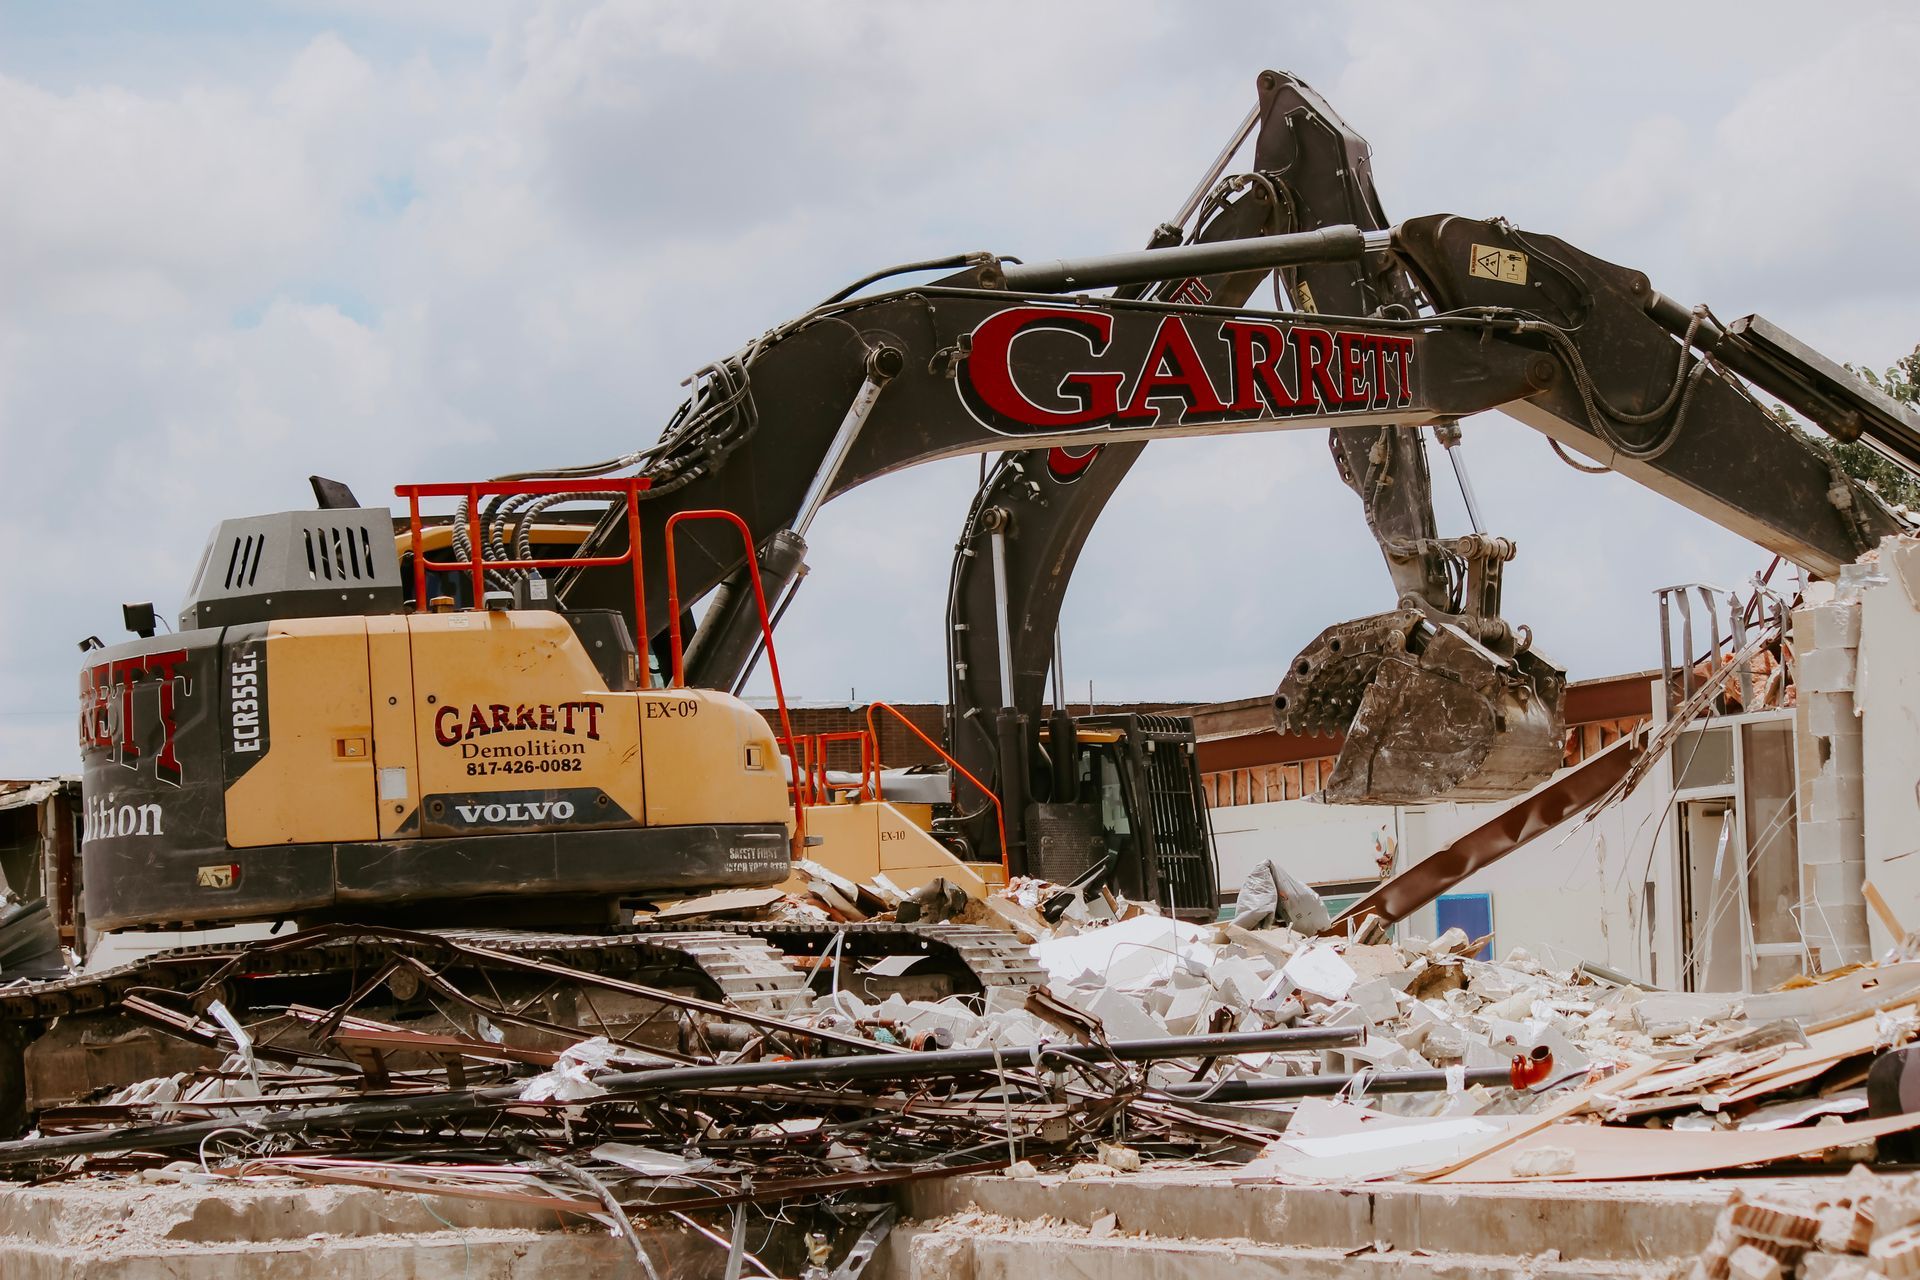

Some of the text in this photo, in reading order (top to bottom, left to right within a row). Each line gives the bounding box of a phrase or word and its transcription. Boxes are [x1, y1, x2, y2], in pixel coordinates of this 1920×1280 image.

[955, 306, 1416, 437] GARRETT
[645, 700, 699, 720] EX-09
[461, 739, 586, 759] Demolition
[466, 759, 583, 776] 817-426-0082
[455, 801, 575, 823] VOLVO
[881, 830, 906, 841] EX-10
